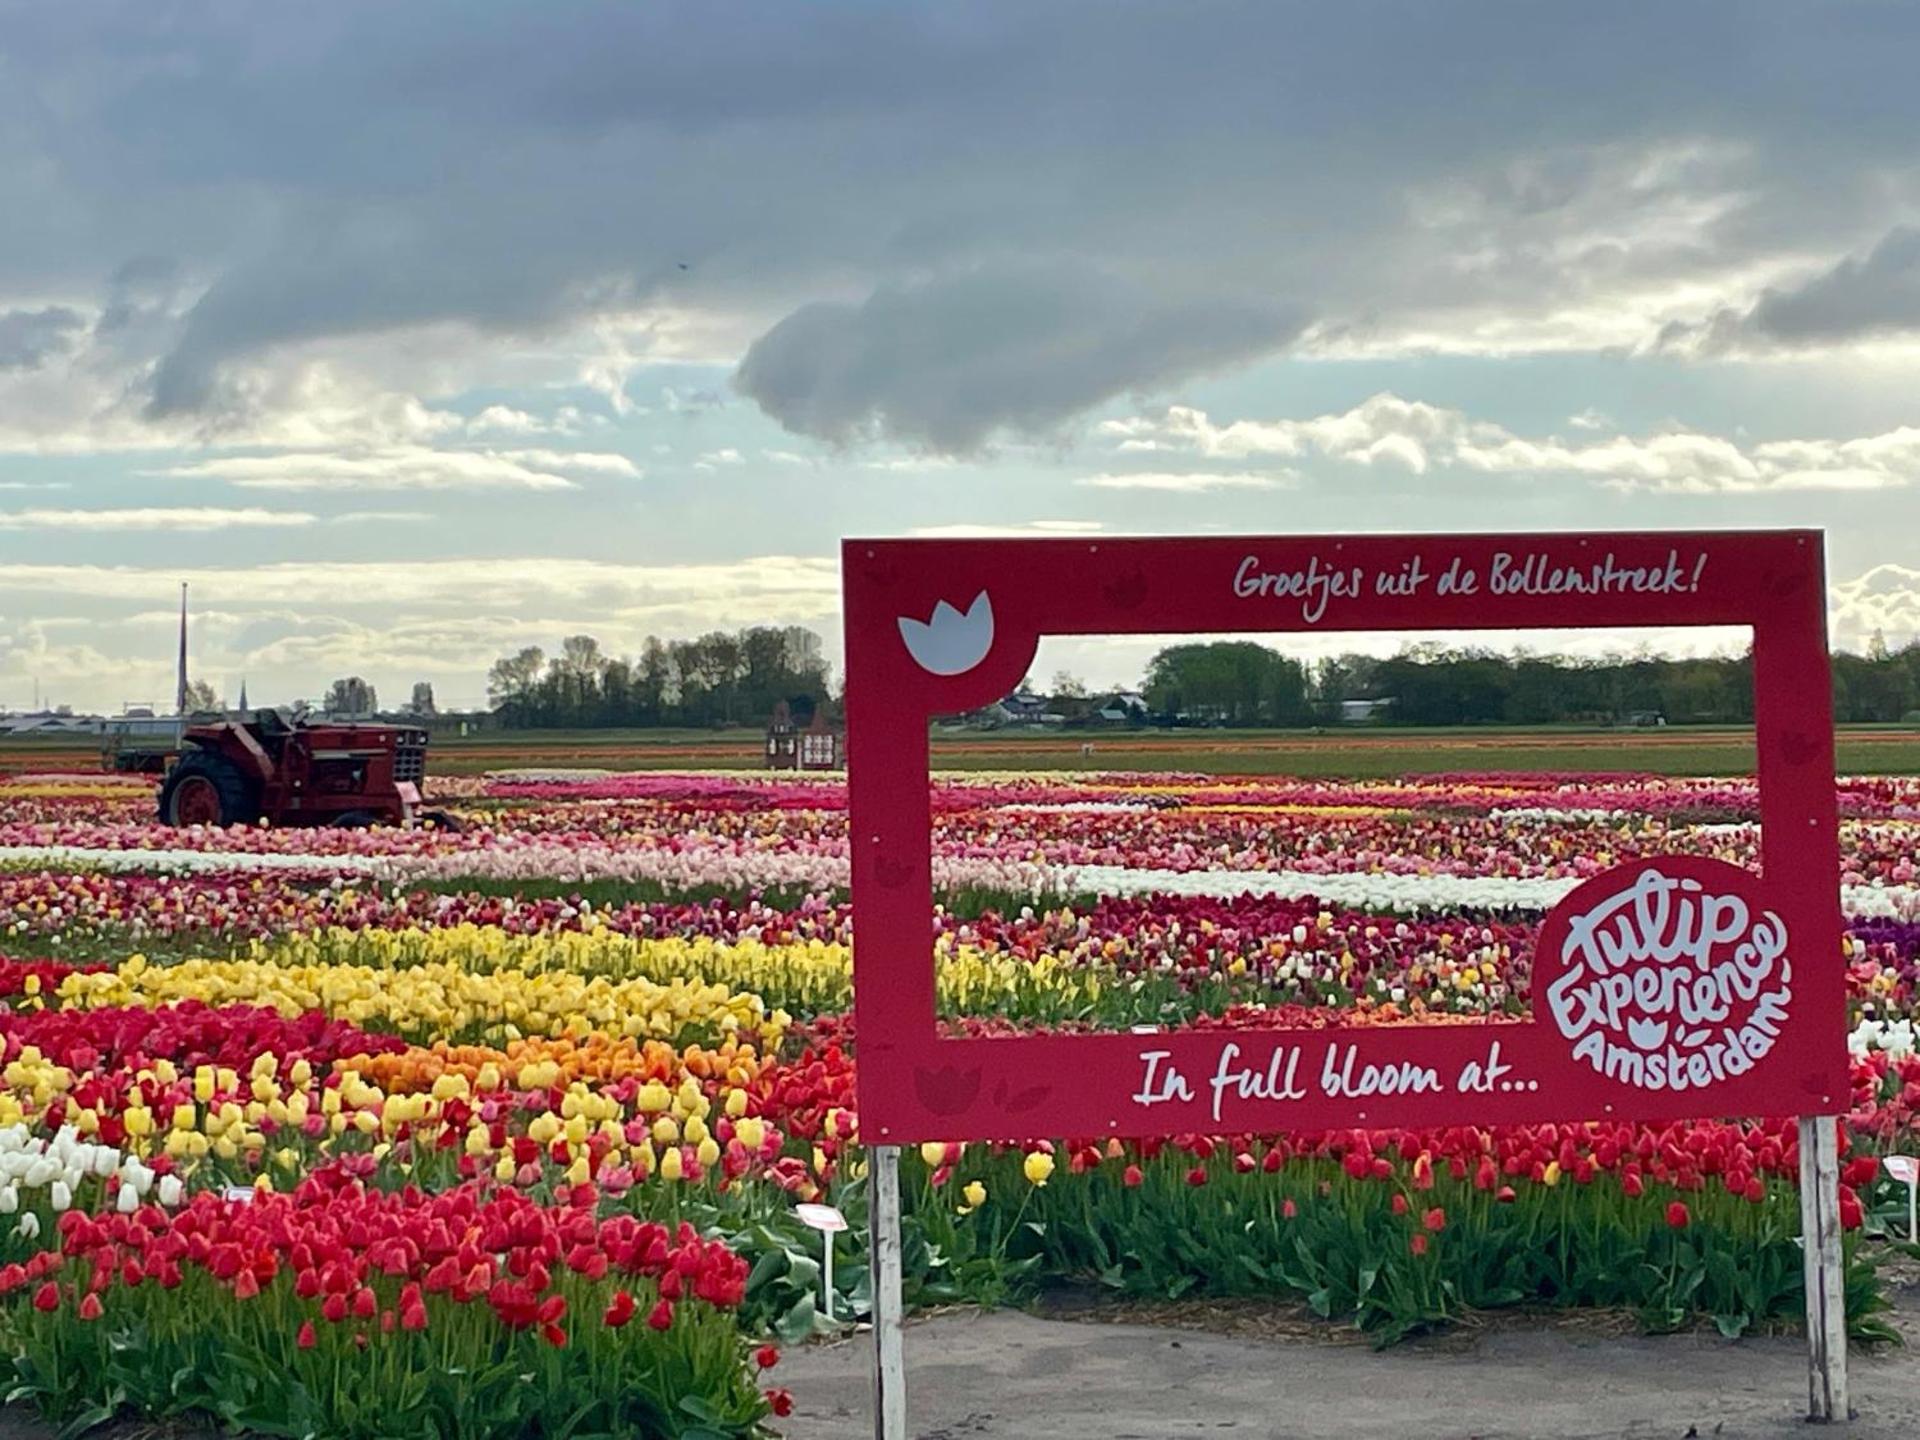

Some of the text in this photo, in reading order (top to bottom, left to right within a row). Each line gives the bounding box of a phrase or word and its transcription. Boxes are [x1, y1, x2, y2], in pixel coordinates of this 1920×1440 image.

[1233, 550, 1707, 622] Groetjes uit de Bollenstreek!
[1562, 869, 1749, 972] Tulip
[1547, 911, 1788, 1039] Experience
[1132, 1041, 1539, 1121] In full bloom at...
[1572, 985, 1792, 1090] Amsterdam
